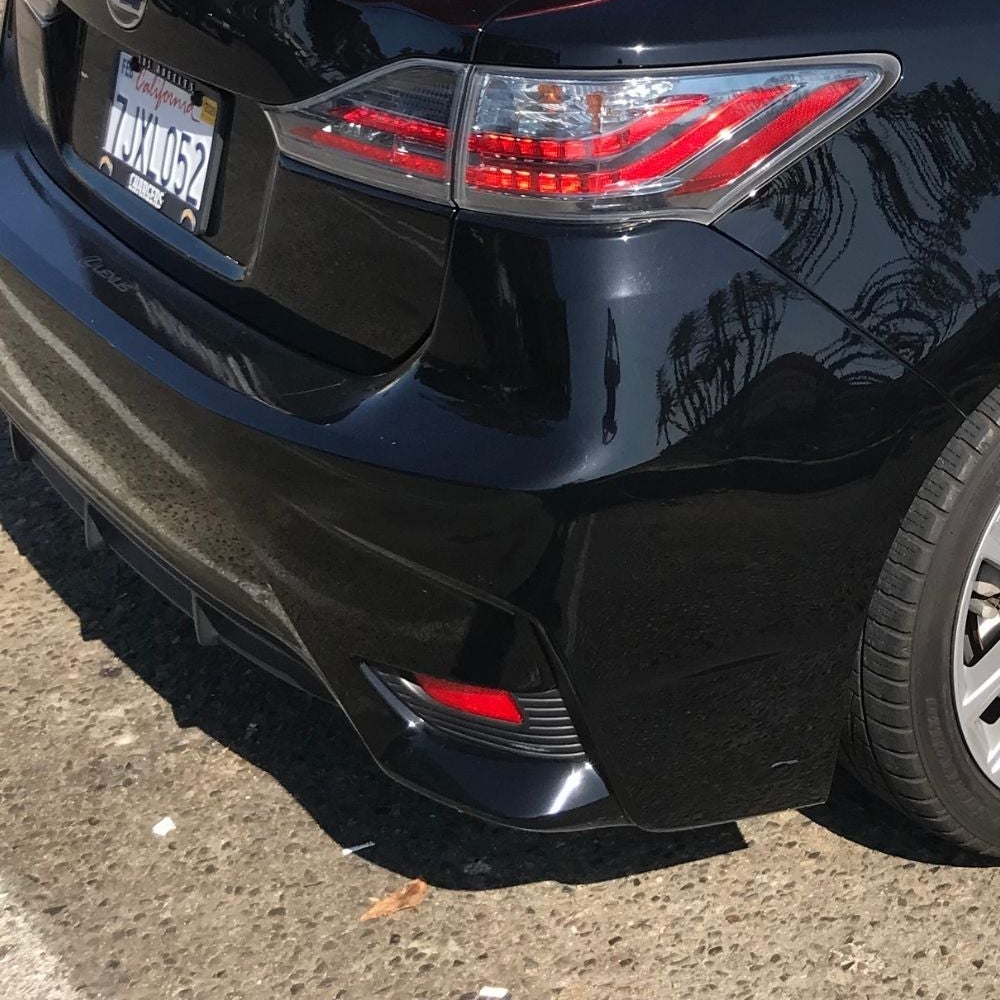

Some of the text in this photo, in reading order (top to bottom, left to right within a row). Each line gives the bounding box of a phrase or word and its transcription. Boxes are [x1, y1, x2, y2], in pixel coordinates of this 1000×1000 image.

[132, 69, 201, 123] California
[111, 94, 207, 206] 7JXL052
[128, 172, 165, 210] CHARGERS
